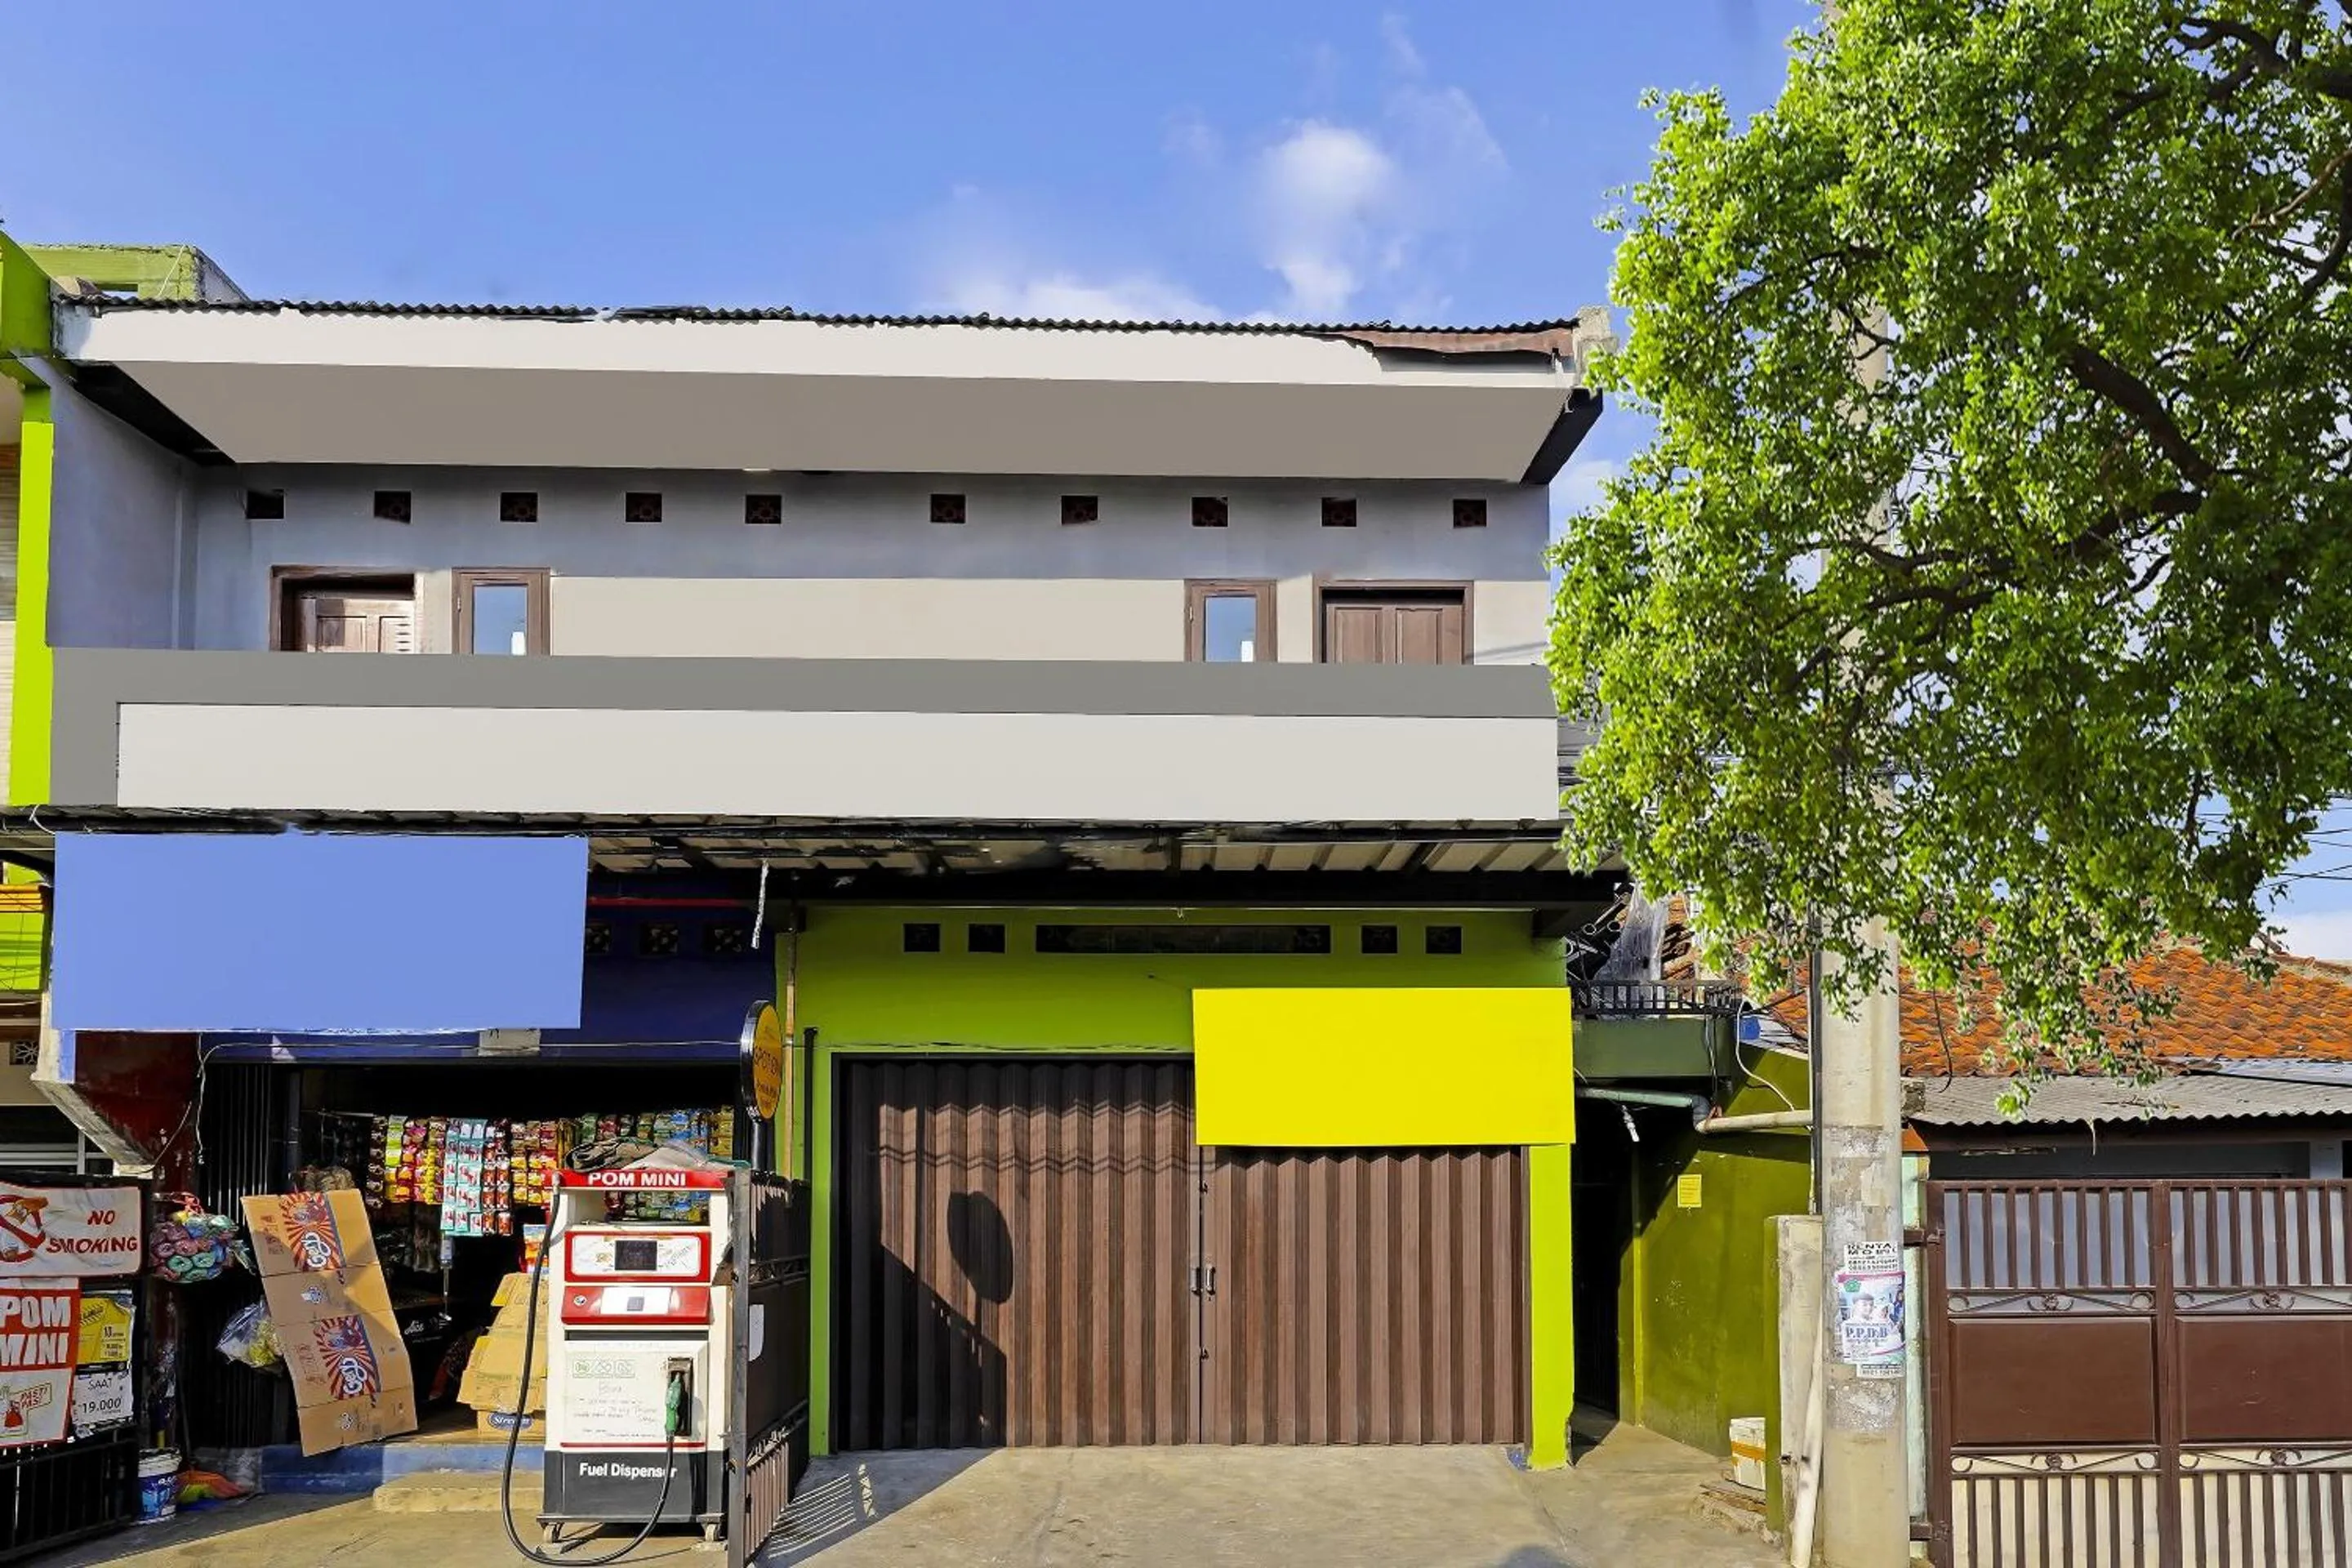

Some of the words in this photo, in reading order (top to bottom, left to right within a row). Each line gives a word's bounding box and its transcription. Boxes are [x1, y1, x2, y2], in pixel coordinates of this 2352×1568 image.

[589, 1172, 635, 1187] POM
[641, 1173, 686, 1187] MINI
[87, 1210, 115, 1225] NO
[46, 1236, 138, 1254] SMOKING
[0, 1295, 72, 1329] POM
[0, 1333, 69, 1366] MINI
[579, 1463, 608, 1476] Fuel
